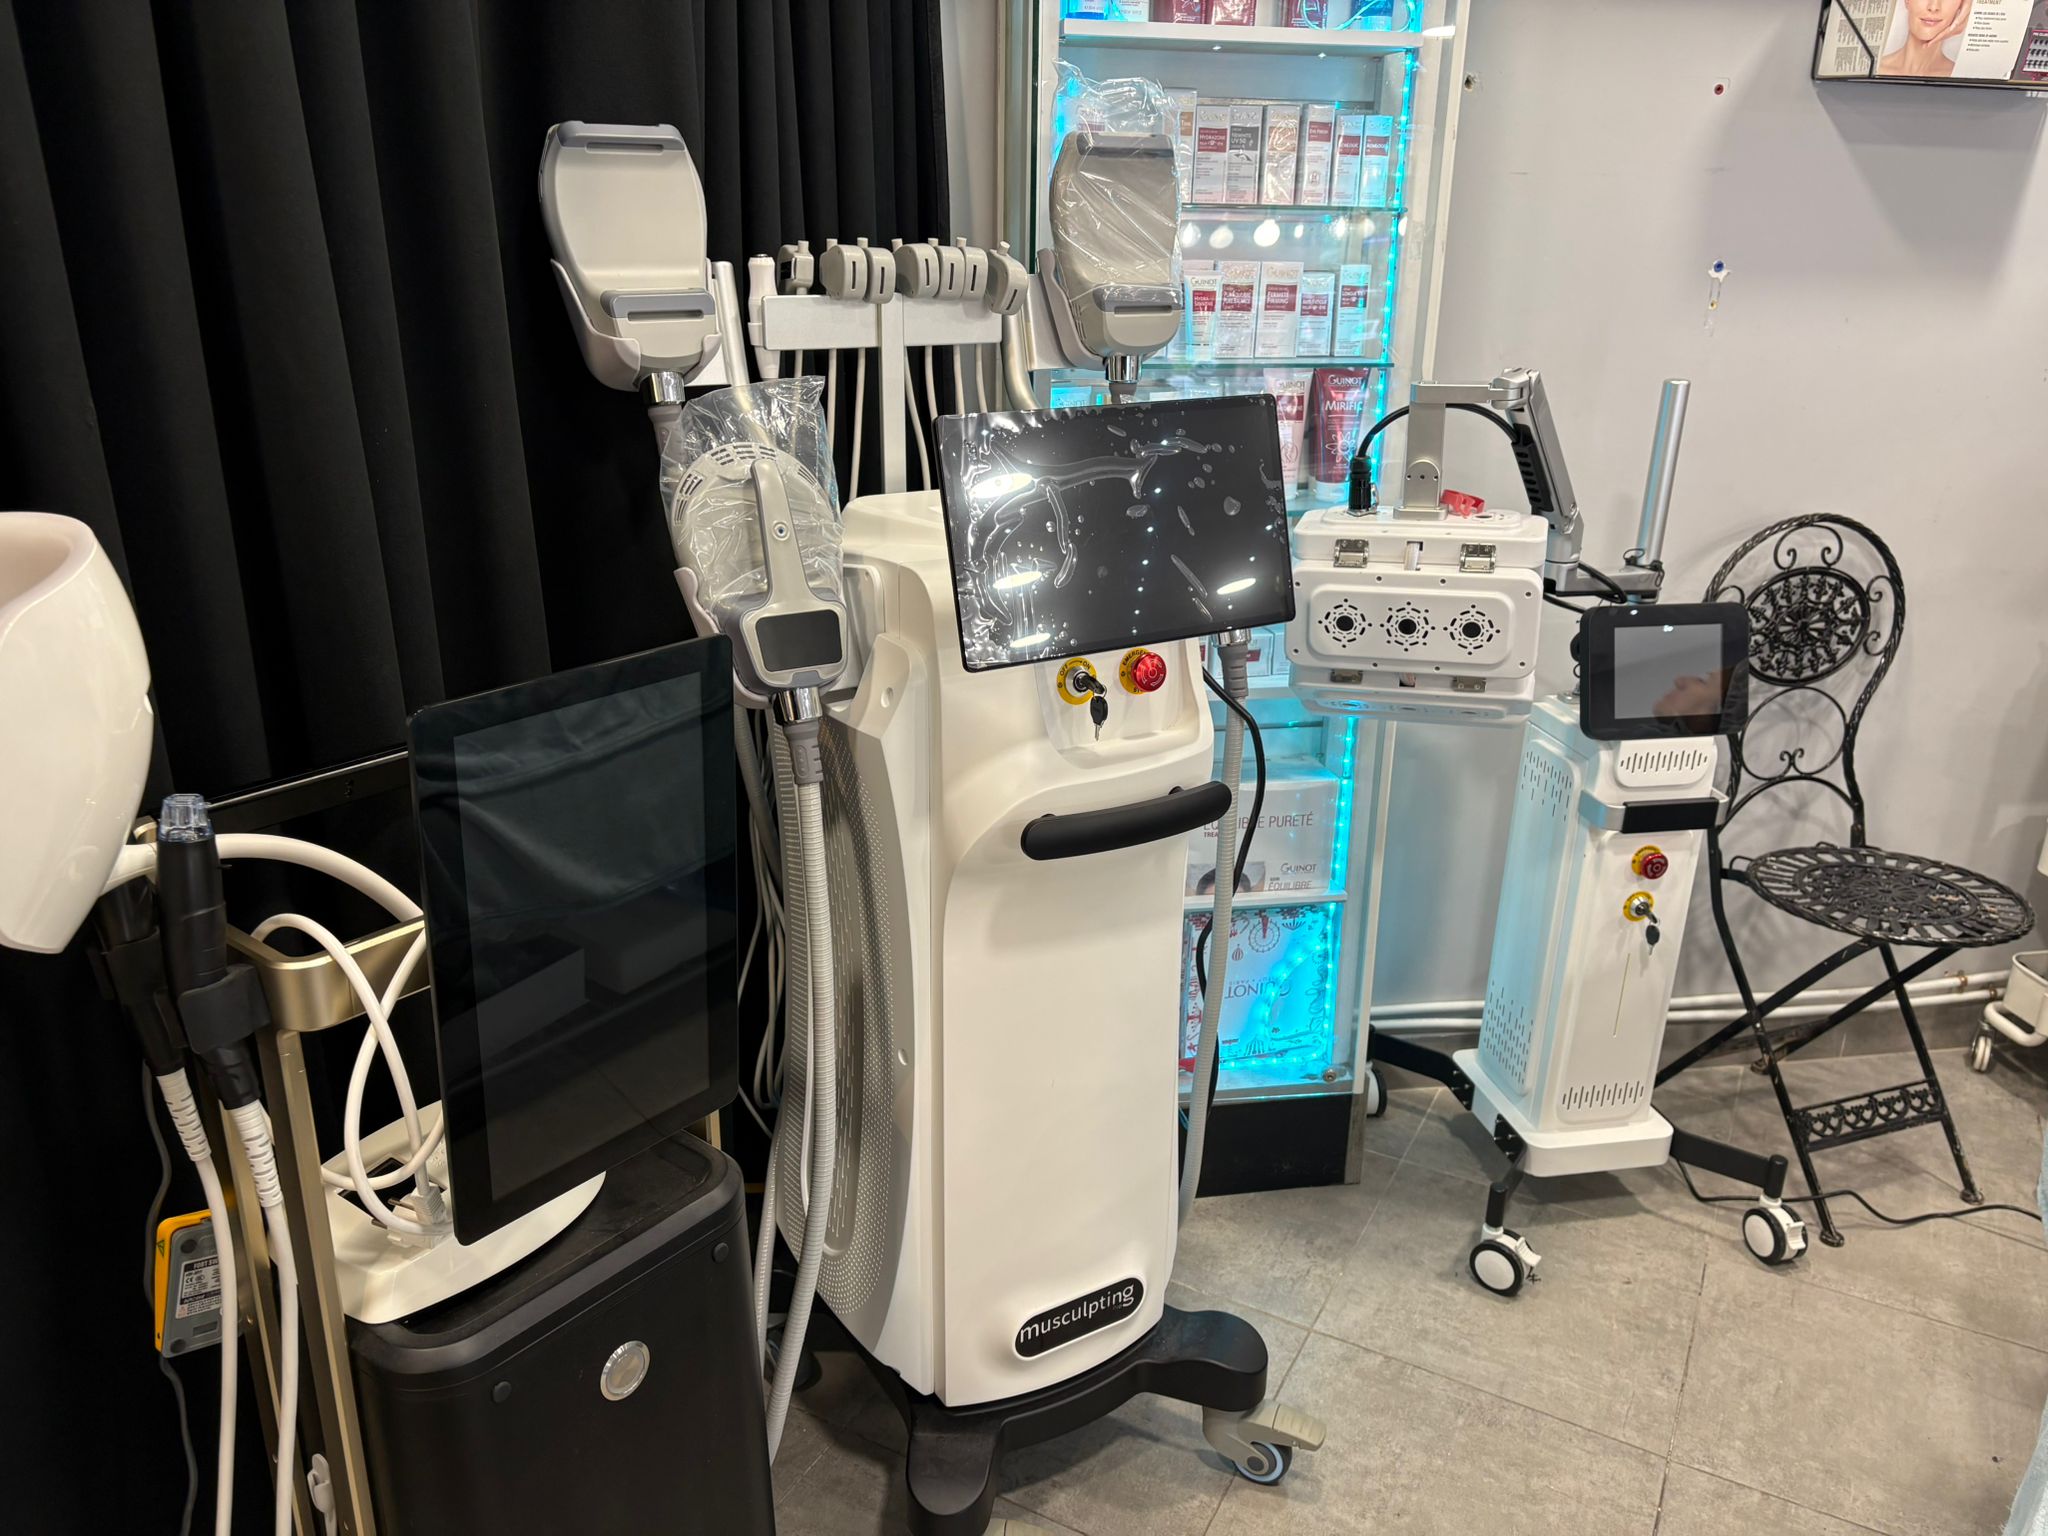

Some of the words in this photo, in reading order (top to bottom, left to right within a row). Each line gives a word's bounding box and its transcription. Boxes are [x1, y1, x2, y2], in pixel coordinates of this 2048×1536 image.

[1191, 277, 1217, 285] GUINOT
[1328, 374, 1363, 385] GUINOT
[1325, 400, 1363, 411] MIRIFIC
[1059, 663, 1069, 676] OFF
[1082, 661, 1091, 670] ON
[1268, 811, 1314, 828] PURETÉ
[1280, 862, 1317, 873] GUINOT
[1268, 880, 1313, 891] ÉQUILIBRE
[1020, 1284, 1135, 1343] musculpting
